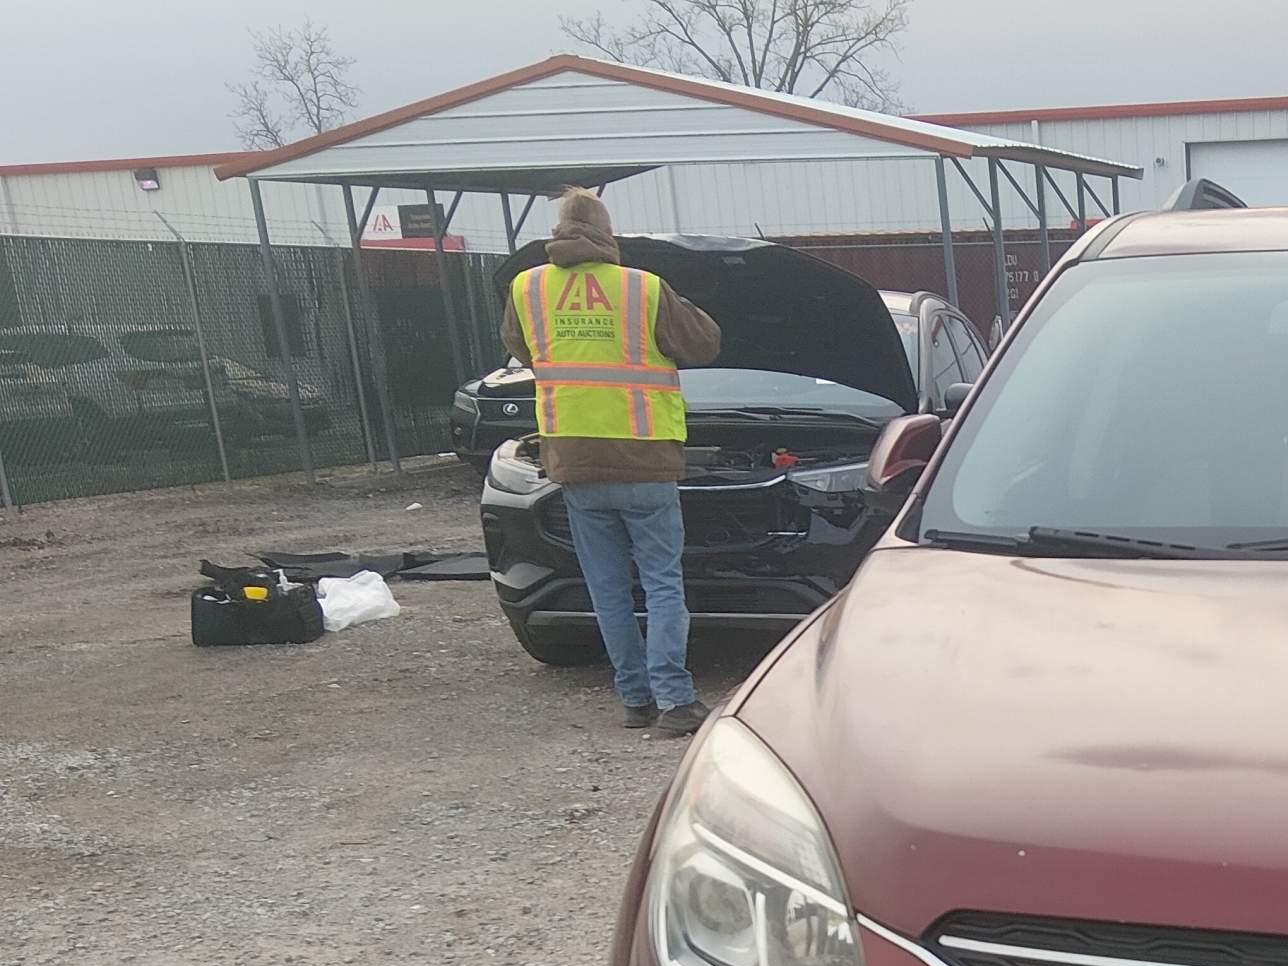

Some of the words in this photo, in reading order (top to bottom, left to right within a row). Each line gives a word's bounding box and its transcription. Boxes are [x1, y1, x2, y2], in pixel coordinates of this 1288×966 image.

[555, 318, 615, 326] INSURANCE
[556, 329, 576, 338] AUTO
[577, 330, 616, 338] AUCTIONS
